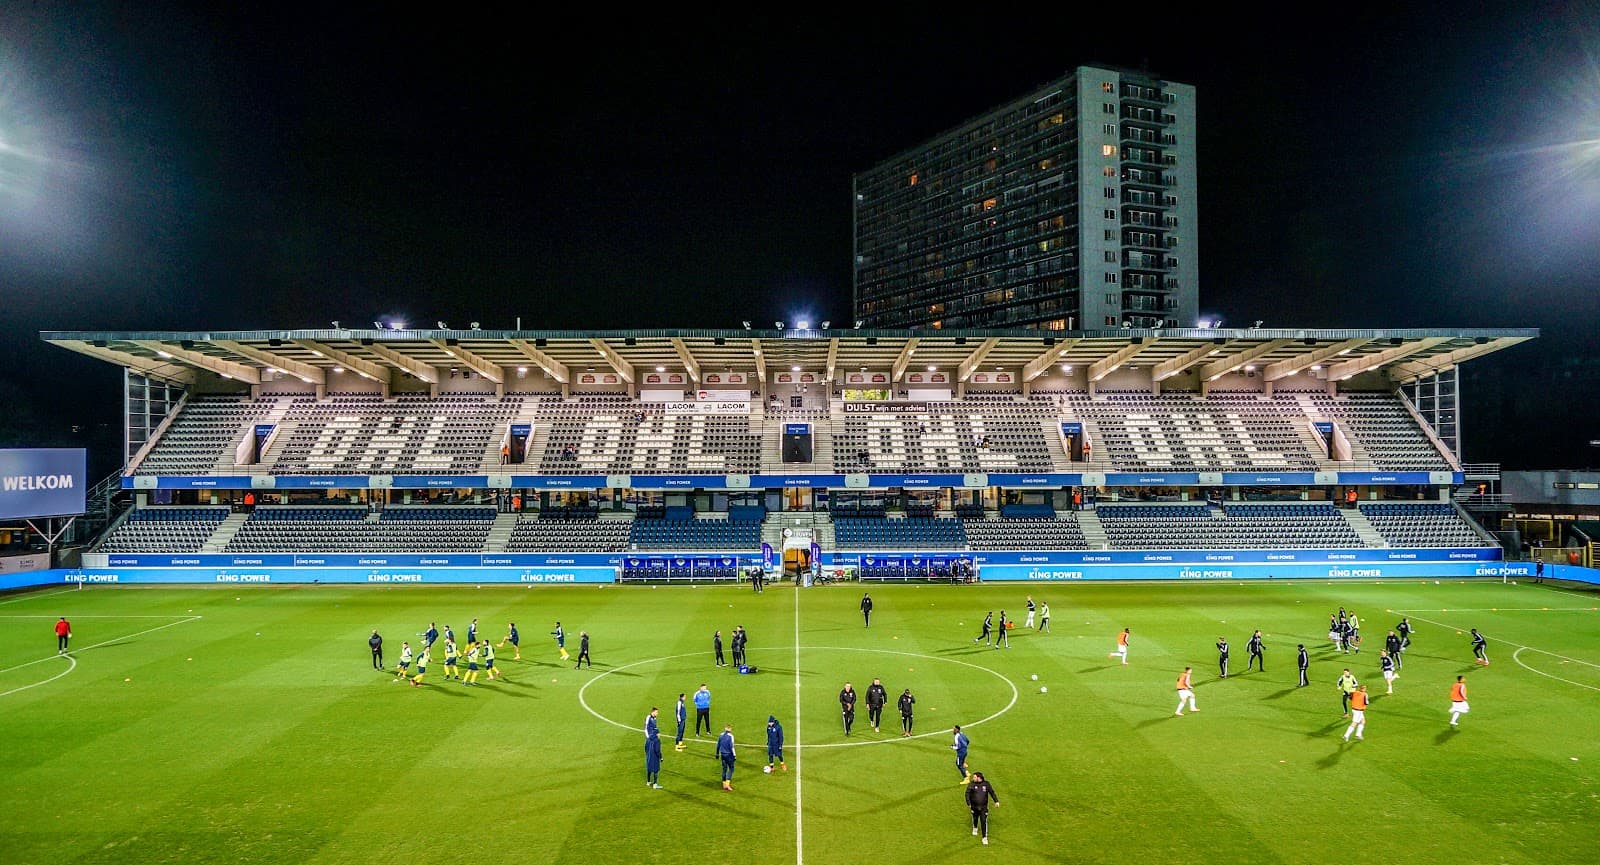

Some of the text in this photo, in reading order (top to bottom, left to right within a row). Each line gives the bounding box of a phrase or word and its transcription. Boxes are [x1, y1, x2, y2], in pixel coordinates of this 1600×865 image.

[846, 403, 876, 412] DULST
[3, 474, 73, 491] WELKOM
[1028, 571, 1082, 579] KING POWER
[1179, 570, 1233, 579] KING POWER
[1328, 569, 1381, 578] KING POWER
[1475, 567, 1528, 575] KING POWER
[64, 574, 119, 583] KING POWER
[216, 574, 270, 583] KING POWER
[367, 574, 422, 583] KING POWER
[520, 574, 575, 583] KING POWER
